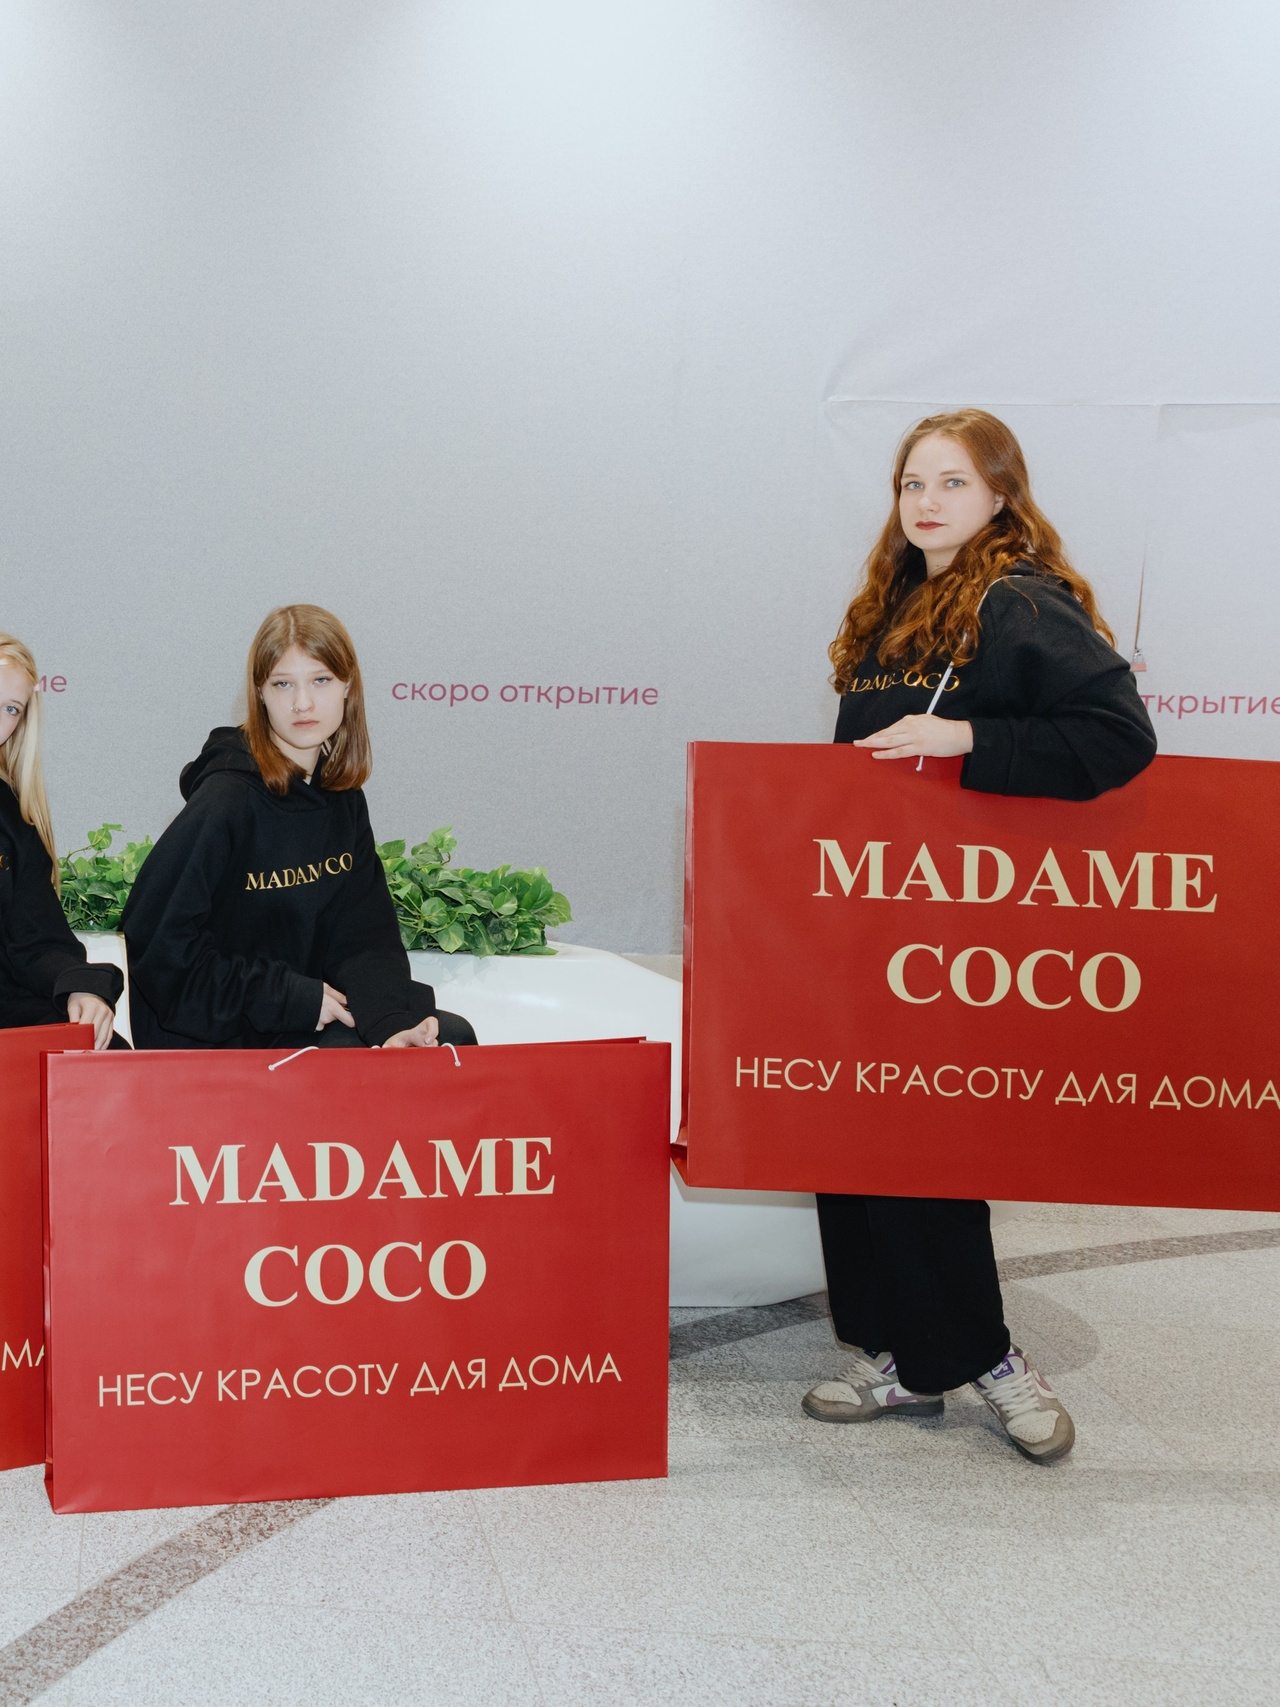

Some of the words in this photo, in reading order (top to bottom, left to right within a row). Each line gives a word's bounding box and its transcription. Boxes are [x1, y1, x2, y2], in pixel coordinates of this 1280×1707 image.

[391, 682, 490, 707] скоро
[499, 684, 659, 710] открытие
[1140, 694, 1280, 720] ткрытие
[245, 862, 322, 891] MADAM
[812, 838, 1218, 913] MADAME
[886, 943, 1142, 1013] COCO
[735, 1056, 842, 1092] НЕСУ
[856, 1061, 1044, 1101] КРАСОТУ
[1054, 1071, 1137, 1107] ДЛЯ
[1149, 1075, 1280, 1111] ДОМА
[167, 1137, 556, 1206] MADAME
[243, 1239, 487, 1308] COCO
[98, 1370, 203, 1408] НЕСУ
[217, 1362, 399, 1402] КРАСОТУ
[410, 1358, 486, 1397] ДЛЯ
[498, 1352, 622, 1392] ДОМА
